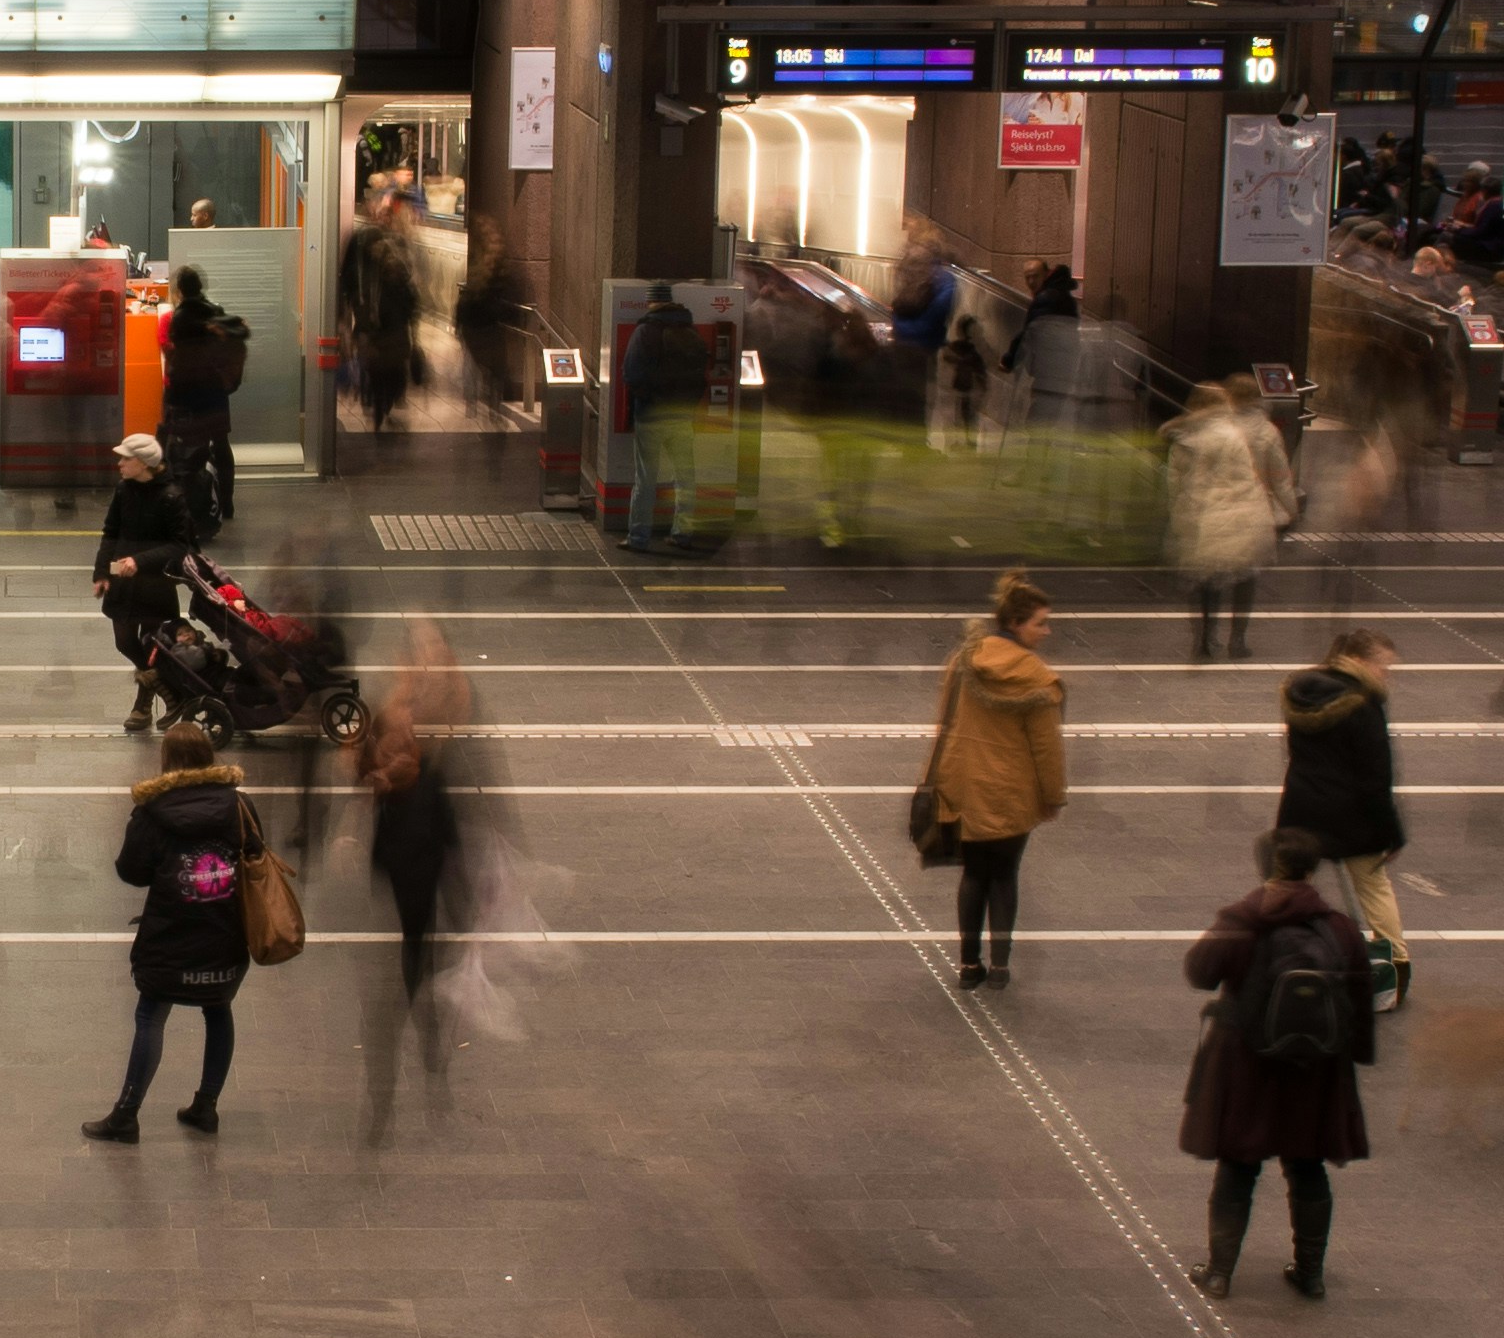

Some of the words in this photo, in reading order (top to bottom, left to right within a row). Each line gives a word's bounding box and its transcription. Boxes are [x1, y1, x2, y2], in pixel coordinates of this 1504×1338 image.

[775, 48, 813, 64] 18:05
[824, 48, 845, 64] Ski
[1025, 48, 1064, 64] 17:44
[1073, 48, 1096, 64] Dal
[729, 59, 748, 84] 9
[1245, 57, 1277, 83] 10
[1010, 128, 1055, 142] Reiselyst?
[1010, 142, 1035, 155] Sjekk
[1035, 142, 1067, 153] nsb.no
